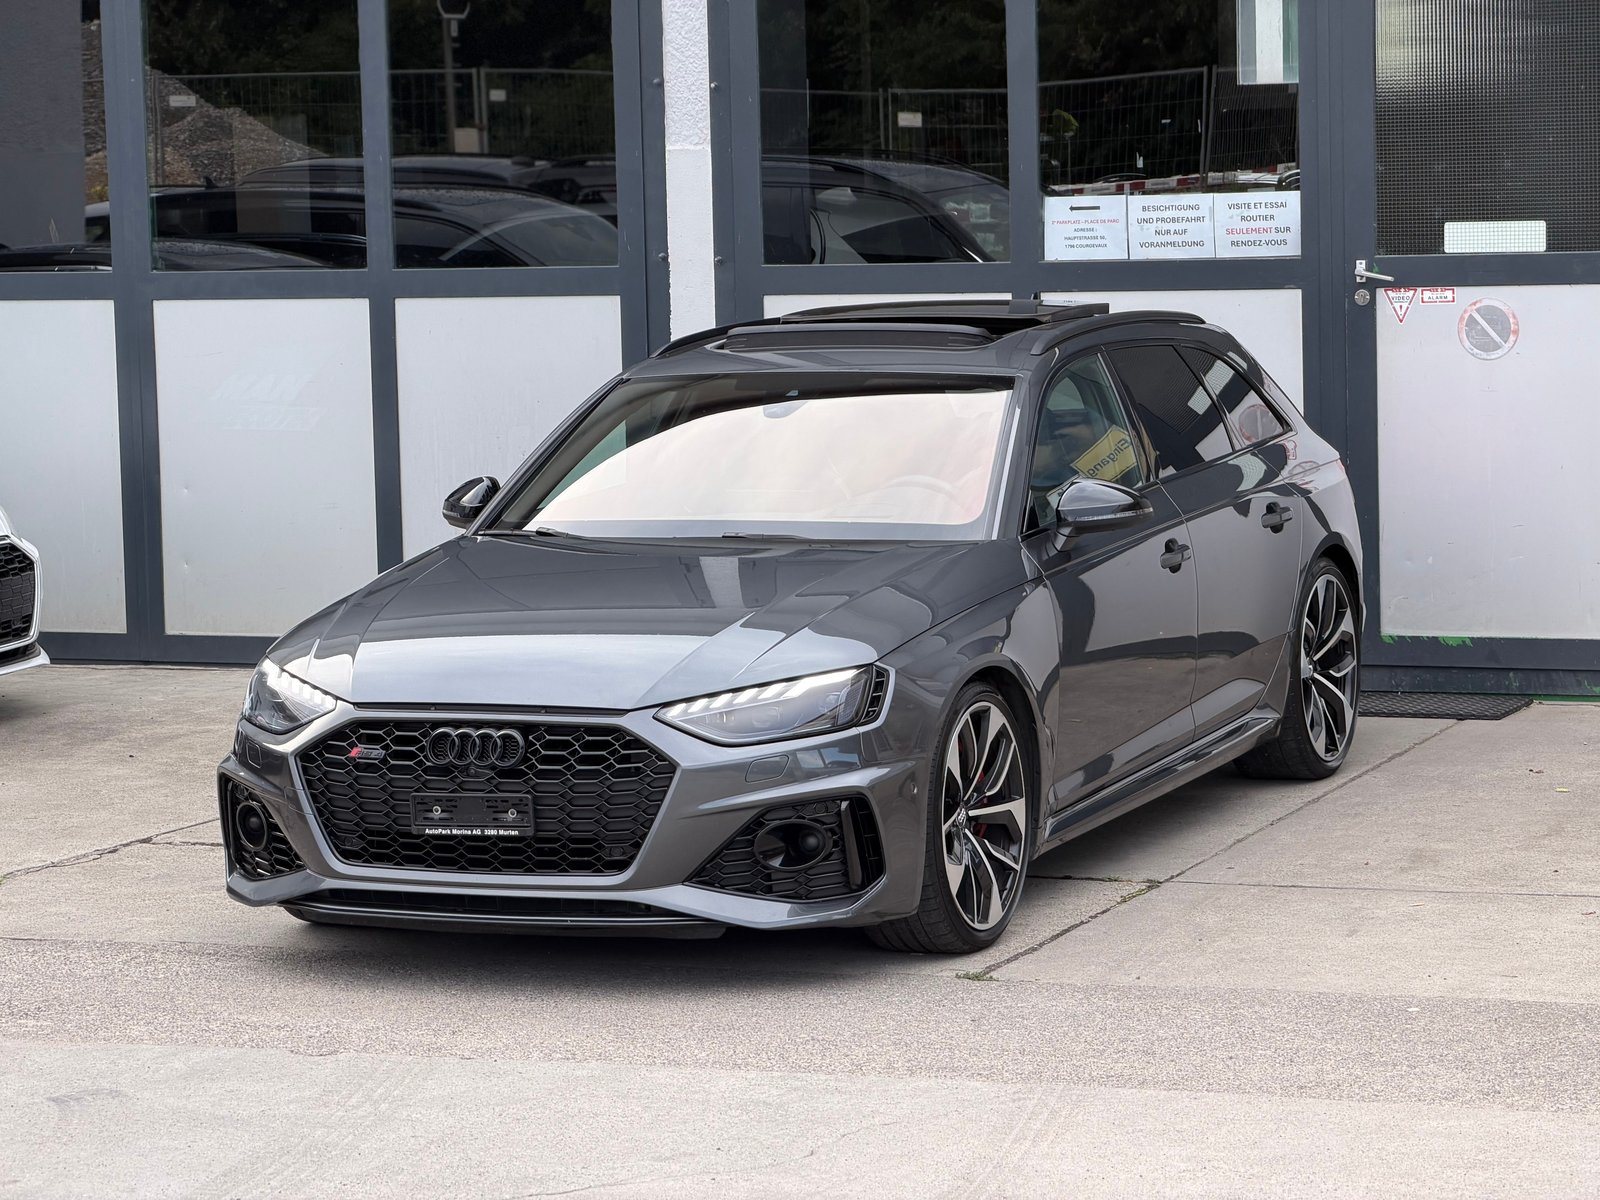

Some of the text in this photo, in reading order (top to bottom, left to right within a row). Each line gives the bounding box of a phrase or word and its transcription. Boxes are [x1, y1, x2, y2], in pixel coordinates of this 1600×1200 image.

[1141, 204, 1200, 212] BESICHTIGUNG
[1227, 202, 1252, 210] VISITE
[1264, 201, 1287, 209] ESSAI
[1155, 216, 1206, 224] PROBEFAHRT
[1240, 214, 1275, 222] ROUTIER
[1172, 228, 1188, 236] AUF
[1225, 227, 1273, 235] SEULEMENT
[1138, 240, 1205, 248] VORANMELDUNG
[1230, 238, 1288, 247] RENDEZ-VOUS
